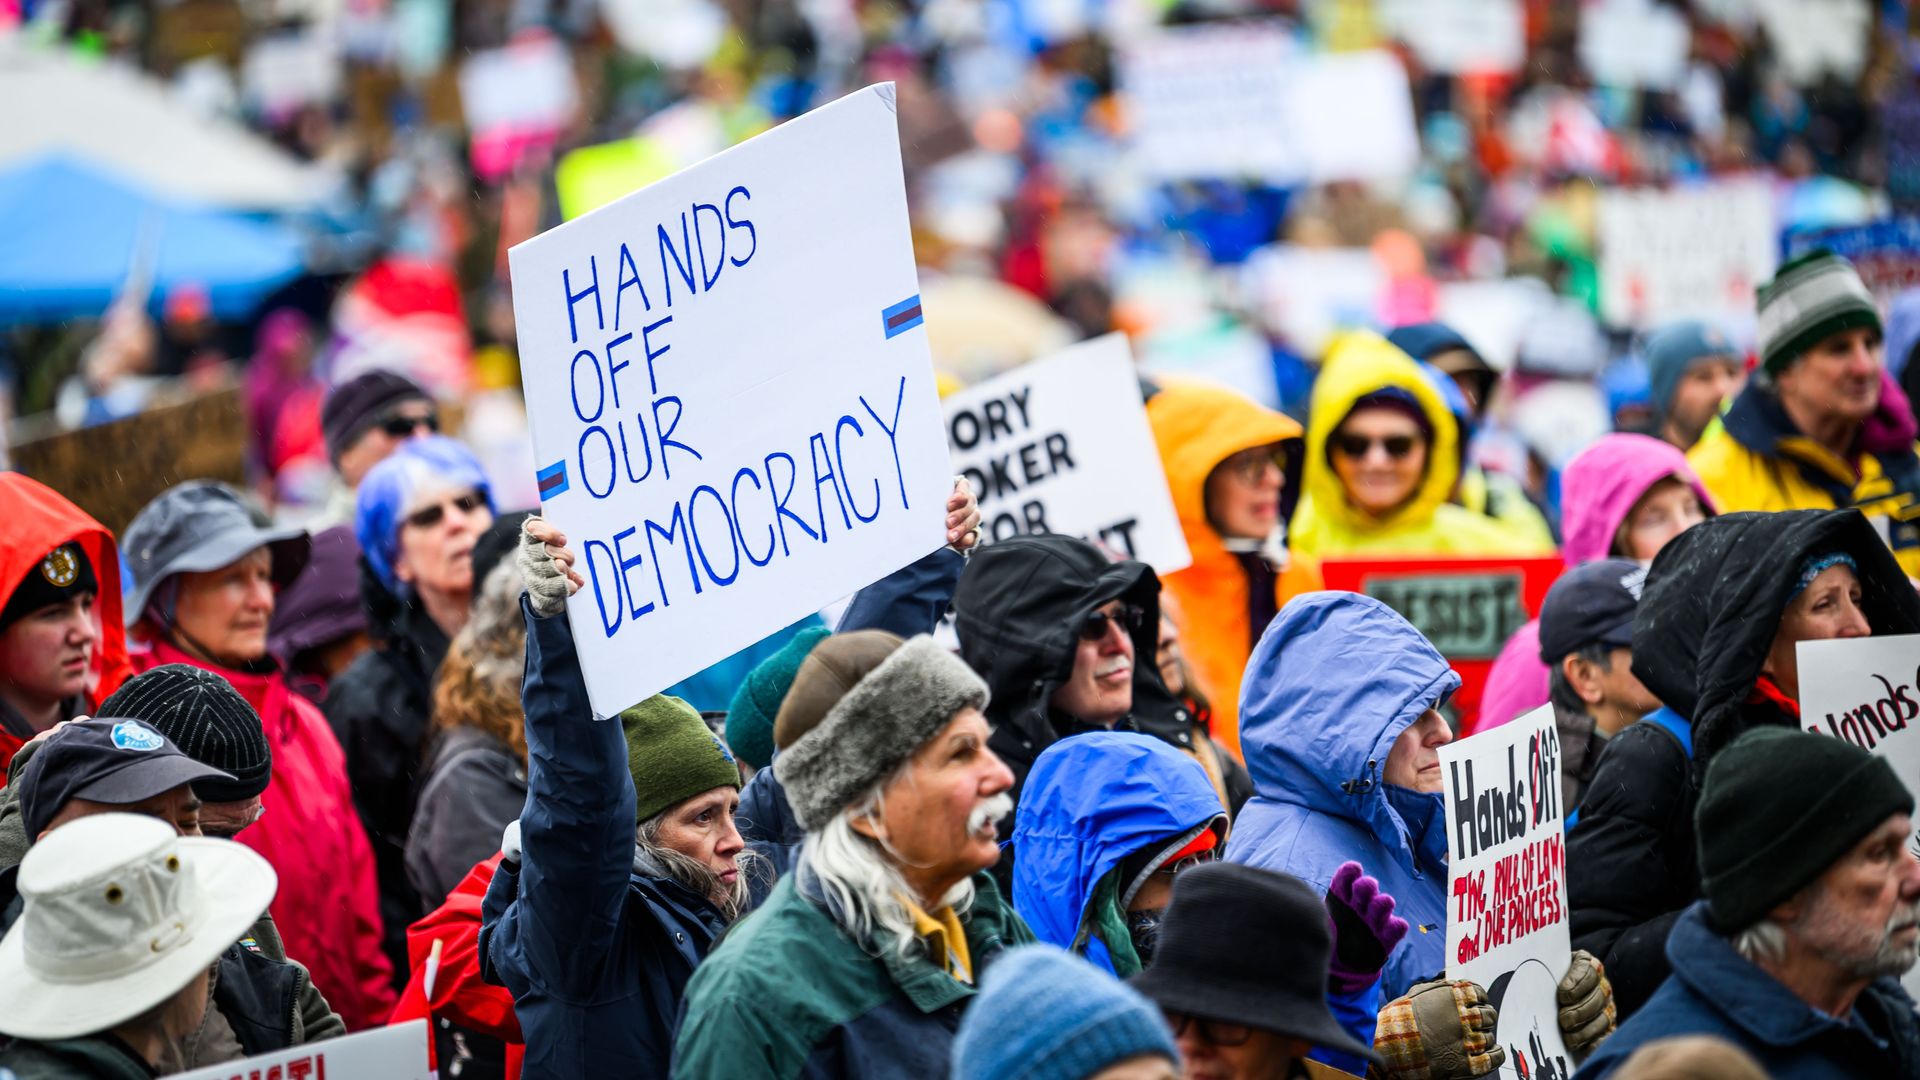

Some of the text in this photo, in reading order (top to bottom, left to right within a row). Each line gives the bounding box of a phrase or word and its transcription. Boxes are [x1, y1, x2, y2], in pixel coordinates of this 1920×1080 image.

[562, 185, 757, 344] HANDS
[570, 315, 673, 424] OFF
[578, 395, 702, 499] OUR
[583, 376, 909, 639] DEMOCRACY
[979, 499, 1050, 546] OR
[1450, 743, 1526, 860] Hands
[1484, 902, 1506, 953] DUE
